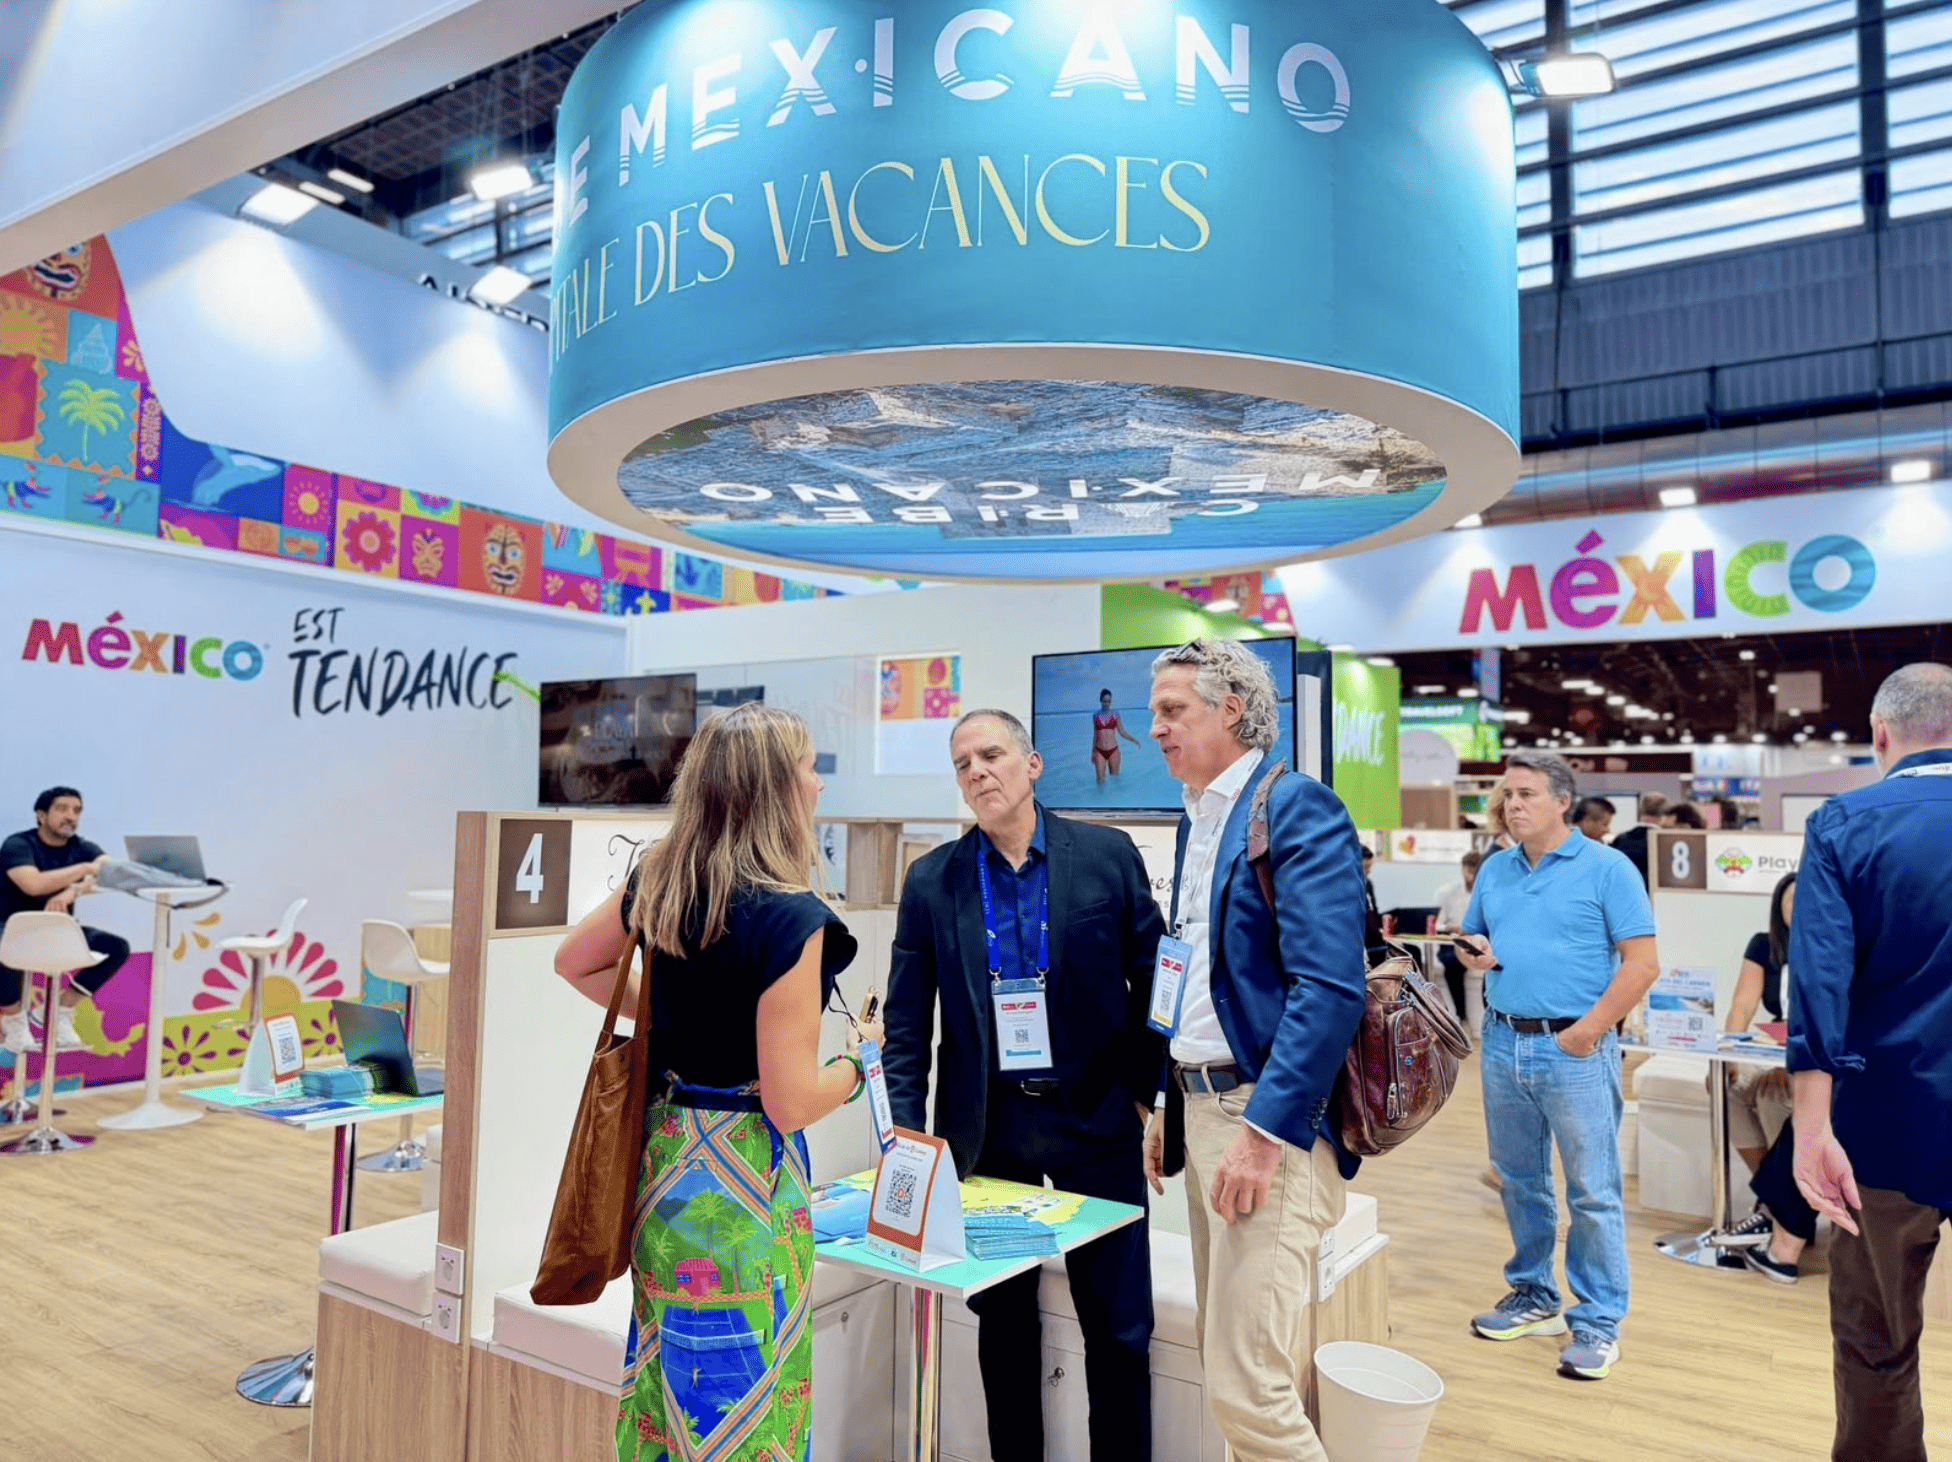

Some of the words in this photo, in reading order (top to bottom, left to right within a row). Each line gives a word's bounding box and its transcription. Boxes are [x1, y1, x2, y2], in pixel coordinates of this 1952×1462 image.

[634, 192, 736, 306] DES
[763, 154, 1211, 266] VACANCES
[293, 607, 345, 643] EST
[288, 646, 518, 718] TENDANCE
[515, 832, 545, 904] 4
[1671, 840, 1691, 879] 8
